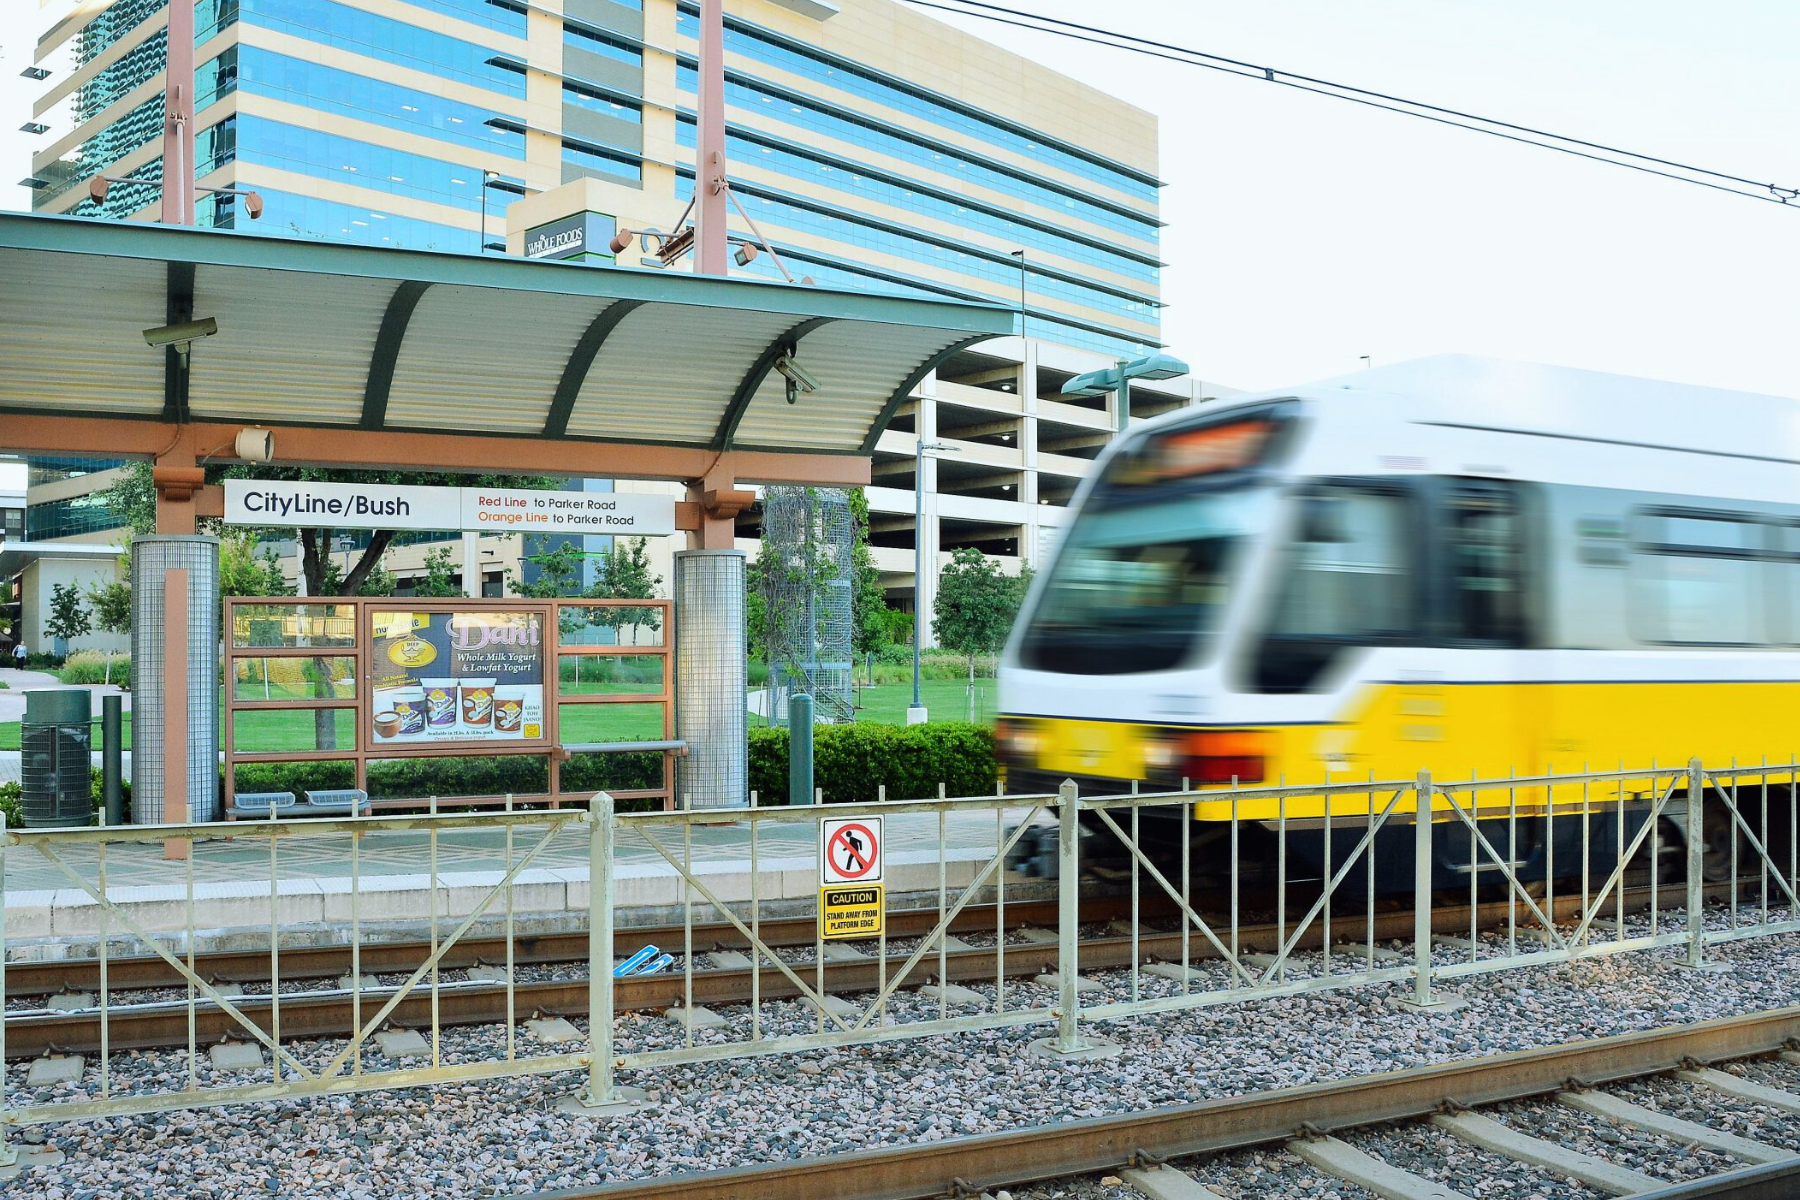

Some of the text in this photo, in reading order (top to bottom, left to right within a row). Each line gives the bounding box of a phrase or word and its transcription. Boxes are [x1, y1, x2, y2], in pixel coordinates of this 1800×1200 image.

[527, 234, 555, 254] WHOLE
[556, 227, 583, 246] FOODS
[244, 491, 410, 517] CityLine/Bush
[478, 496, 616, 510] Red Line to Parker Road
[478, 511, 634, 525] Orange Line to Parker Road
[457, 652, 536, 663] Whole Milk Yogurt
[471, 663, 501, 674] Lowfat
[503, 664, 532, 674] Yogurt
[832, 892, 873, 904] CAUTION
[827, 909, 878, 921] STAND AWAY FROM
[830, 919, 874, 930] PLATFORM EDGE
